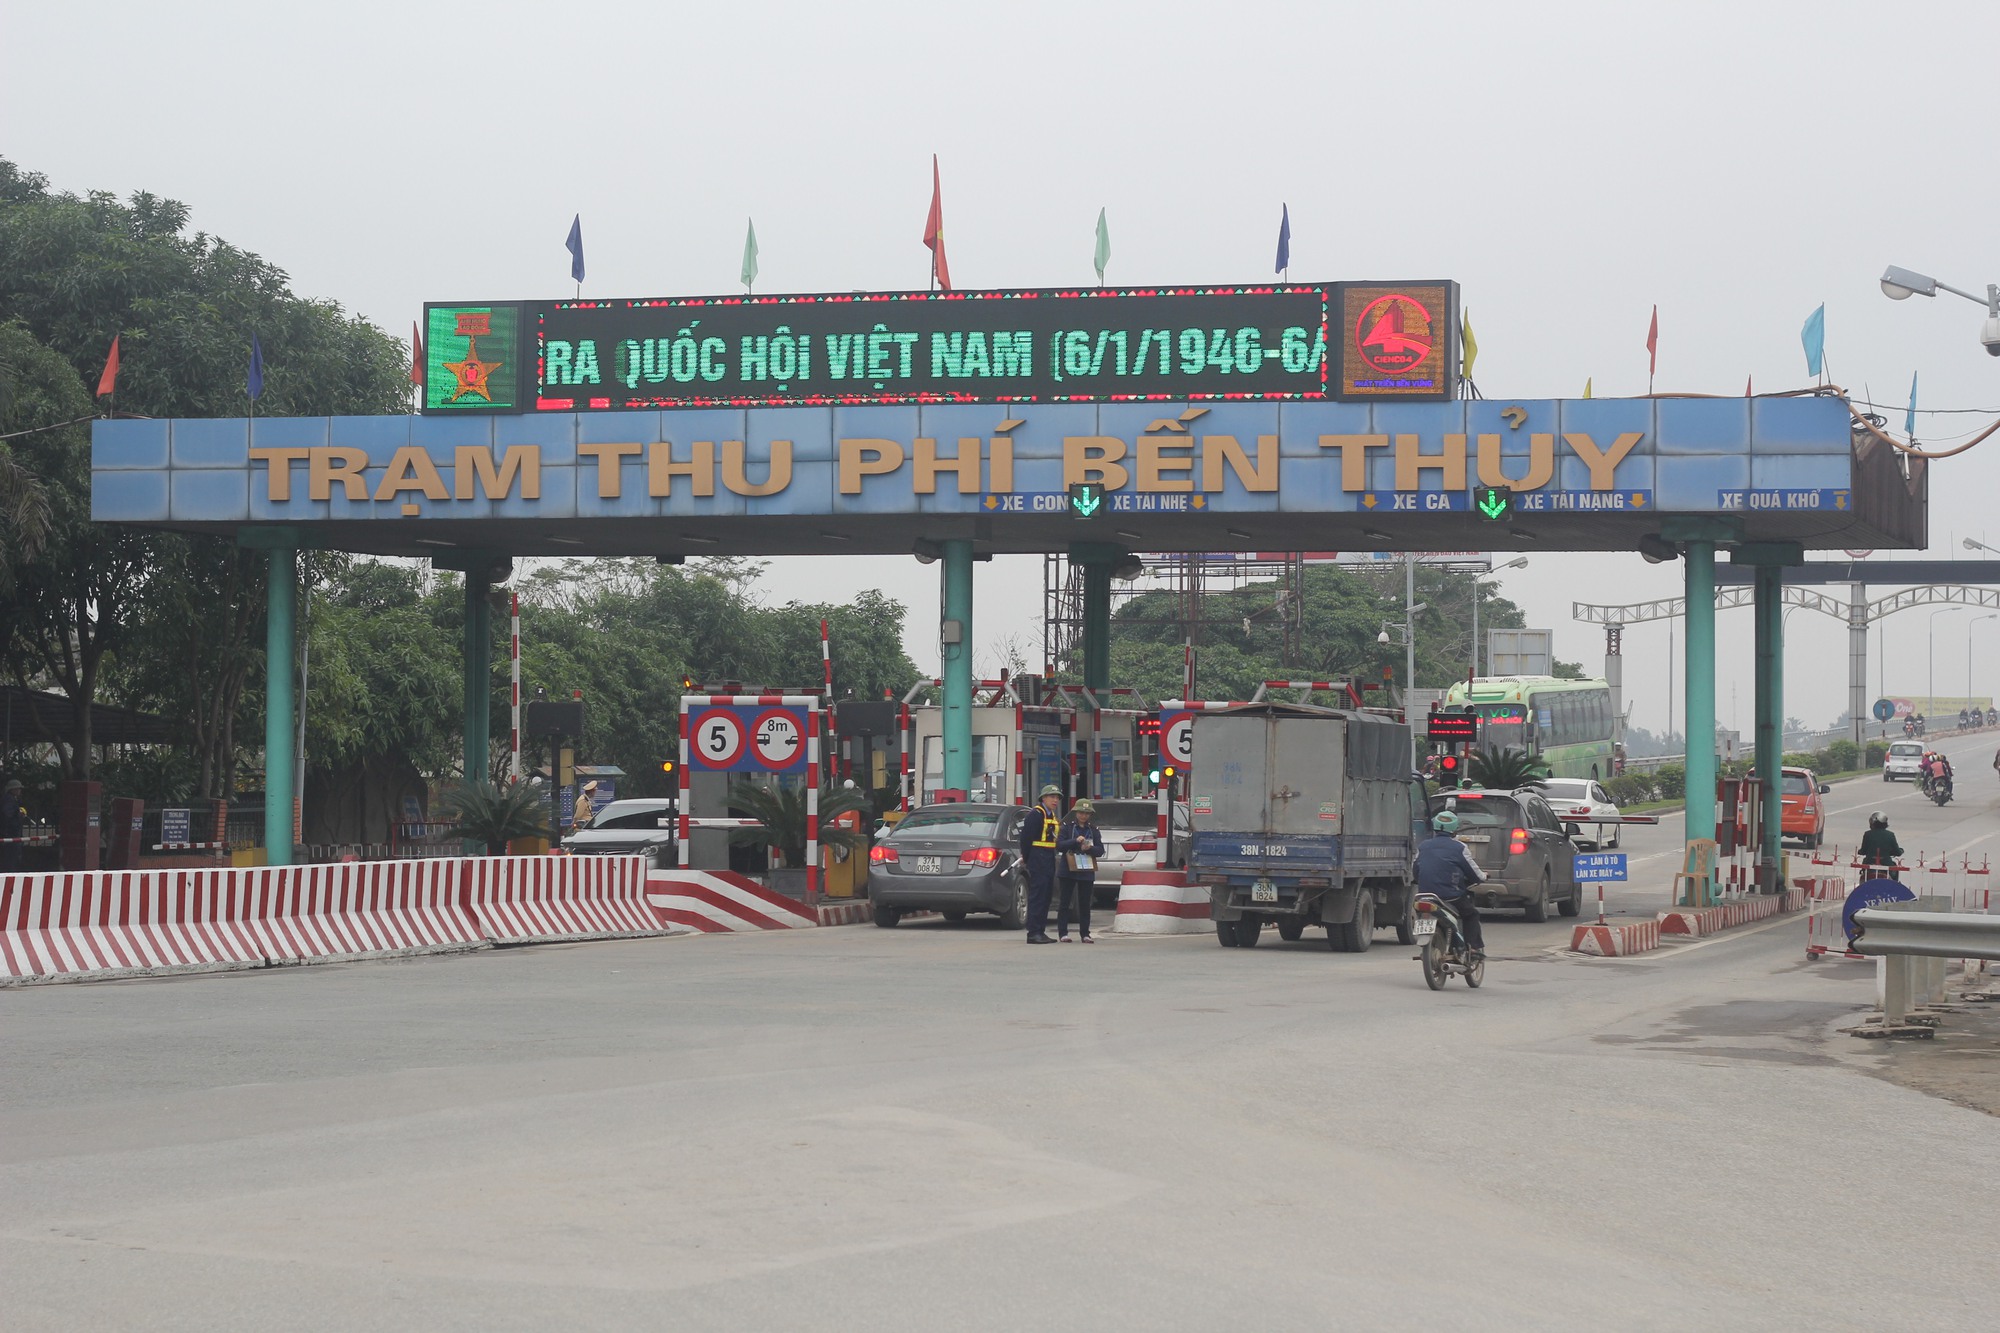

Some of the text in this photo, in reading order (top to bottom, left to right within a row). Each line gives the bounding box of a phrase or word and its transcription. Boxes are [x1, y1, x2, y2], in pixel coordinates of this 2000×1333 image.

[546, 340, 601, 385] RA
[616, 321, 727, 389] QUỐC
[740, 326, 812, 391] HỘI
[825, 324, 919, 389] VIỆT
[930, 330, 1033, 378] NAM
[249, 407, 1645, 516] TRẠM THU PHÍ BẾN THỦY
[1002, 495, 1069, 510] XE CON
[1113, 495, 1131, 510] XE
[1160, 495, 1187, 511] NHẸ
[1393, 494, 1451, 510] XE CA
[1524, 494, 1544, 510] XE
[1579, 490, 1624, 511] NẶNG
[1722, 489, 1822, 510] XE QUÁ KHỔ
[767, 720, 788, 732] 8m
[710, 726, 727, 753] 5
[1178, 729, 1192, 754] 5
[1265, 845, 1287, 857] 1824
[922, 856, 935, 865] 37A
[1590, 856, 1603, 866] LÀN
[1575, 868, 1613, 878] LÀN XE MÁY
[1257, 883, 1273, 892] 38N
[1255, 892, 1274, 901] 1824
